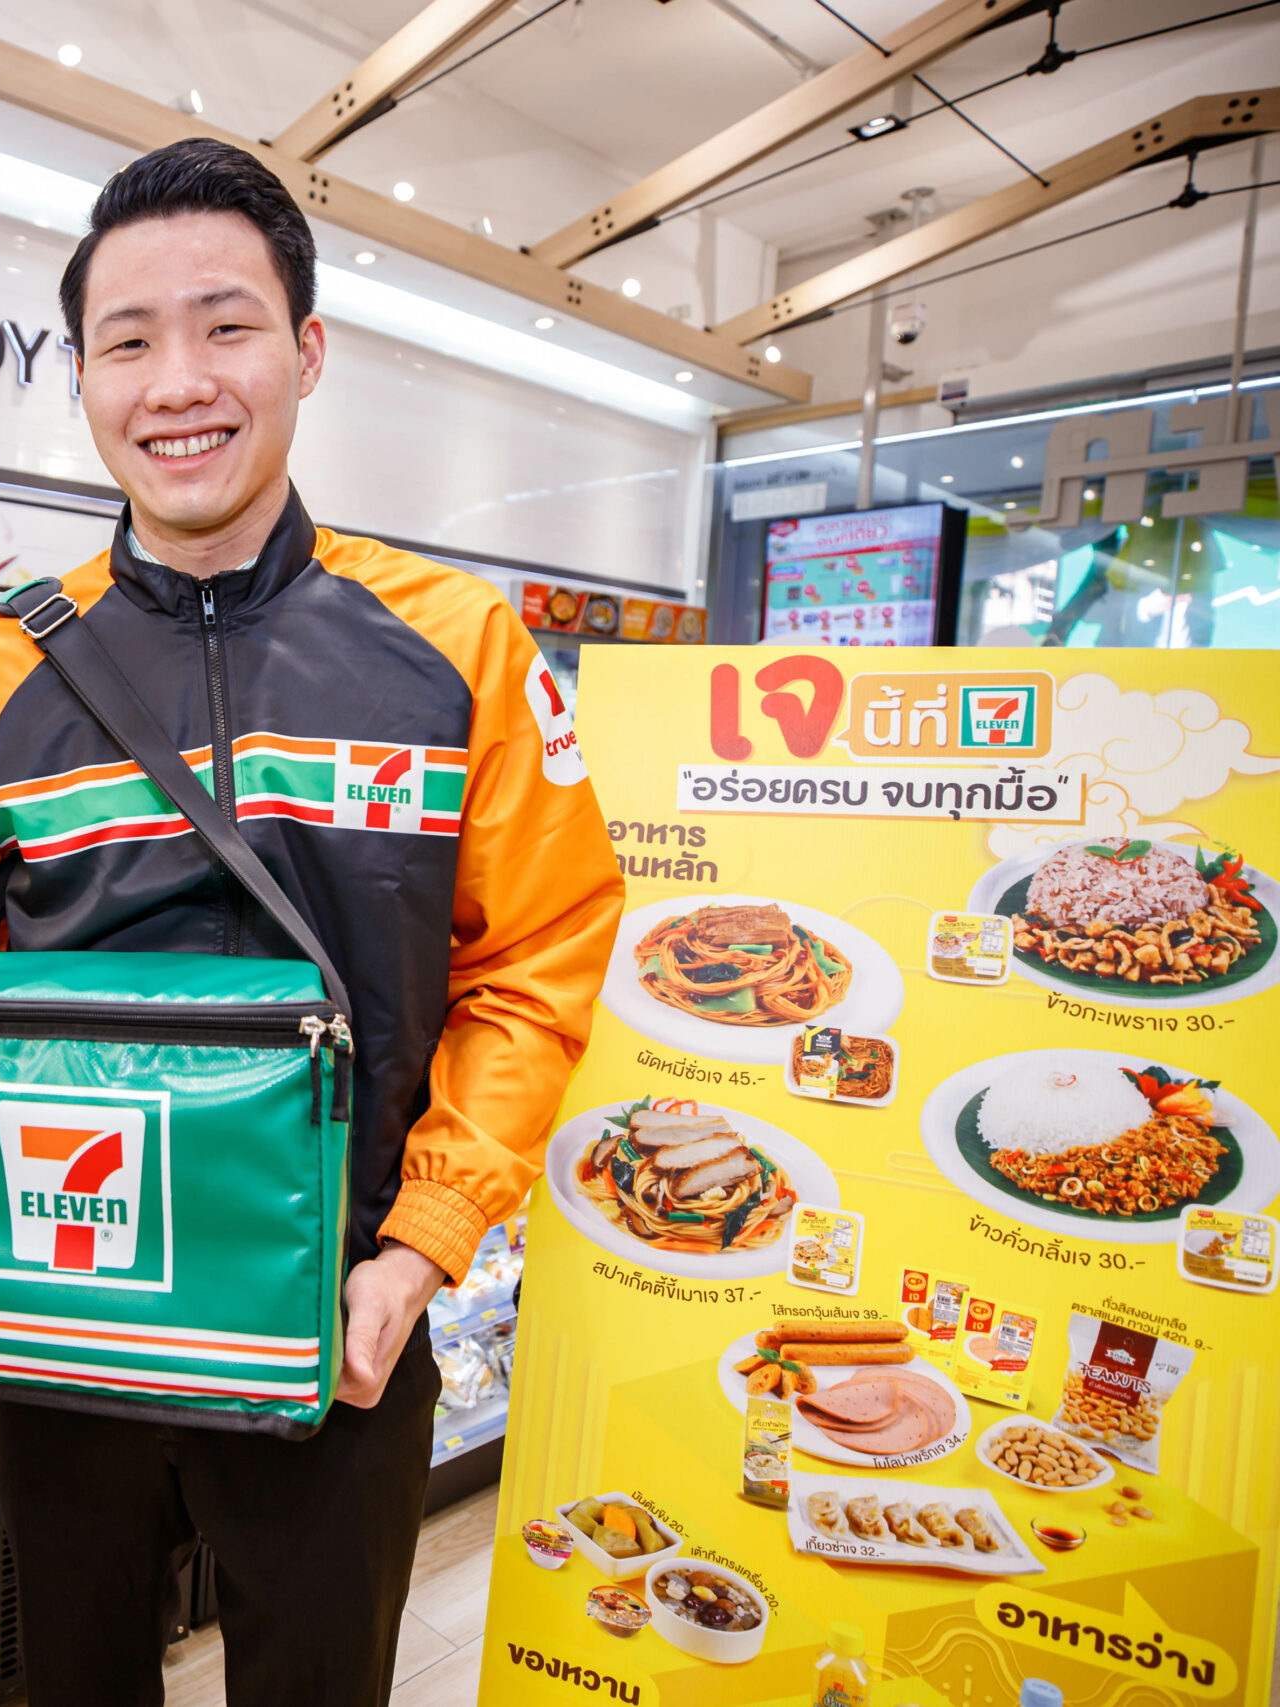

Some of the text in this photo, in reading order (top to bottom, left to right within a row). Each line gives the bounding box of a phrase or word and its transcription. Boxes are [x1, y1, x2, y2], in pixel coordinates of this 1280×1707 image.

[711, 655, 948, 762] เจ นี้ที่
[977, 697, 1019, 745] 7
[975, 719, 1020, 731] ELEVEN
[545, 730, 577, 757] true
[346, 783, 412, 806] ELEVEN
[350, 745, 412, 829] 7
[607, 820, 707, 848] อาหาร
[616, 851, 718, 883] านหลัก
[1047, 991, 1236, 1032] ข้าวกะเพราเจ 30.-
[728, 1071, 767, 1086] 45.-
[20, 1124, 124, 1272] 7
[20, 1190, 129, 1226] ELEVEN
[1098, 1252, 1146, 1270] 30.-
[723, 1286, 762, 1304] 37.-
[907, 1276, 924, 1287] CP
[972, 1304, 989, 1316] CP
[1077, 1361, 1152, 1394] PEANUTS
[996, 1602, 1217, 1687] อาหารว่าง
[507, 1642, 641, 1707] ของหวาน
